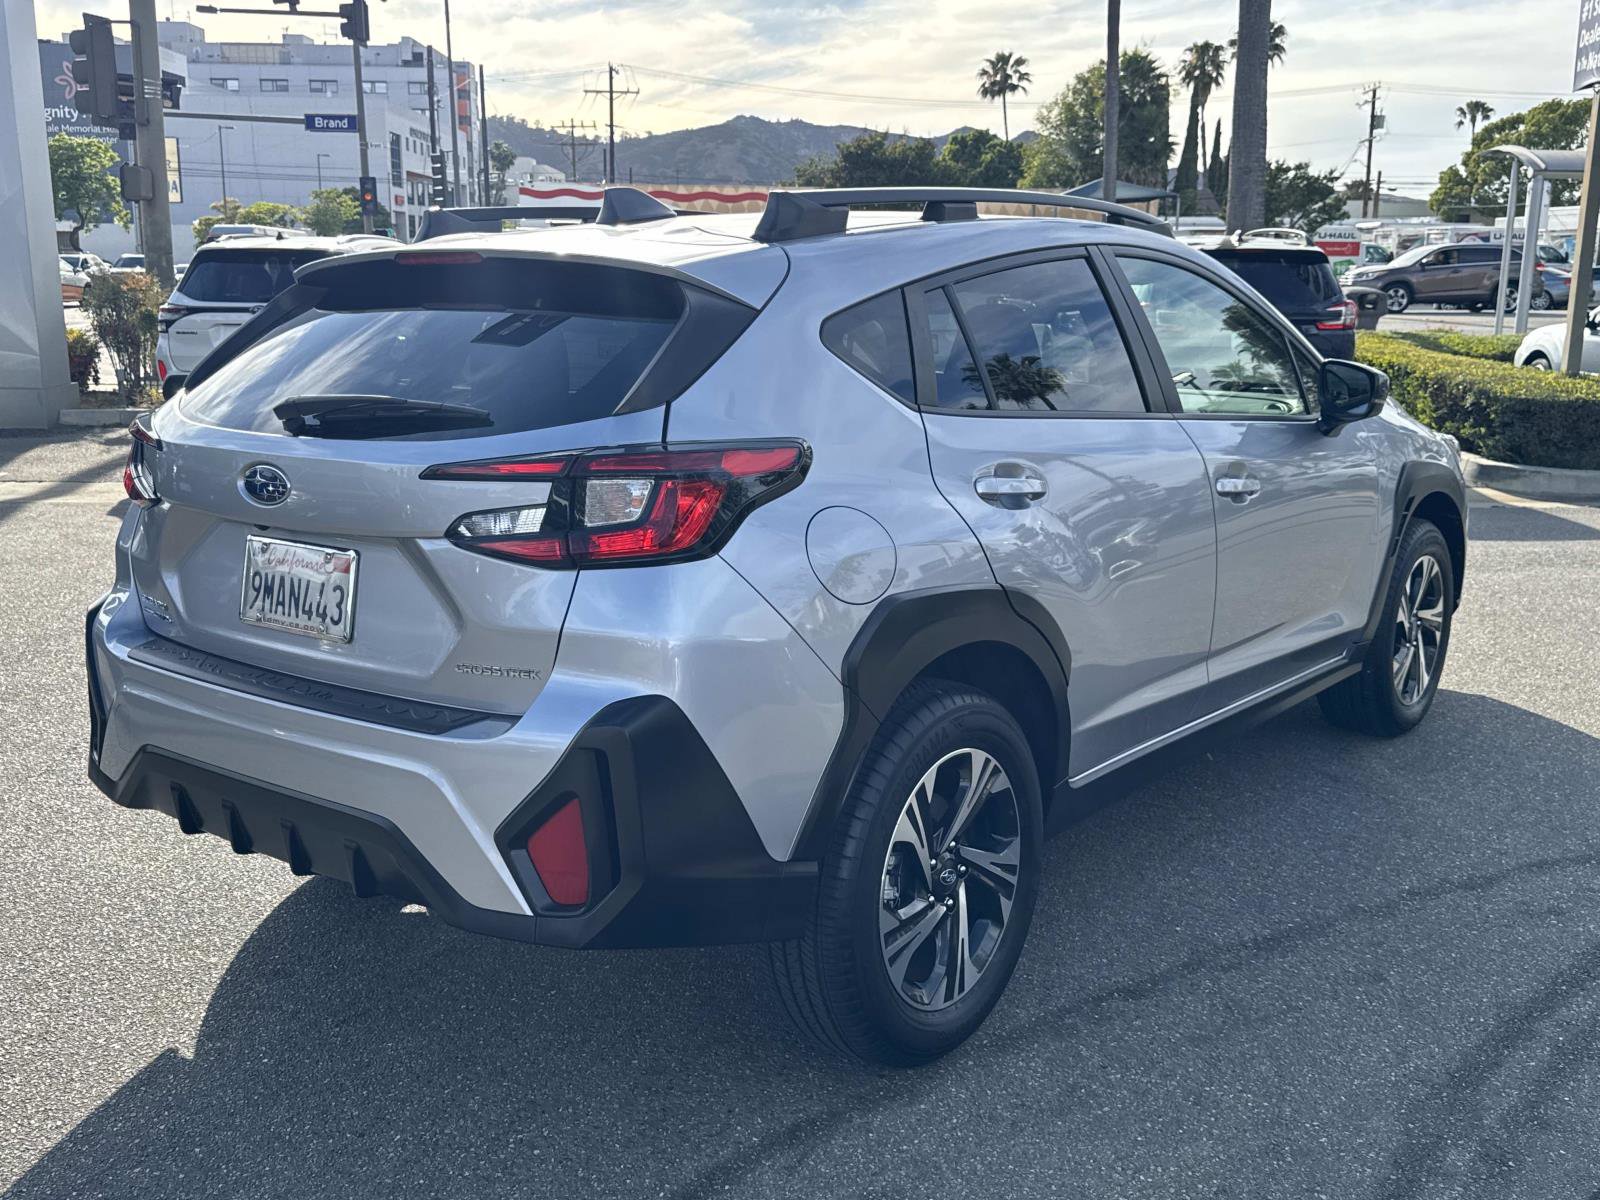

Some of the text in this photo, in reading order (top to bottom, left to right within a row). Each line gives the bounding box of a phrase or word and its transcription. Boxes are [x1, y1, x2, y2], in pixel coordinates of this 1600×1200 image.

[314, 116, 349, 129] Brand
[249, 571, 345, 626] 9MAN443
[455, 663, 542, 681] CROSSTREK
